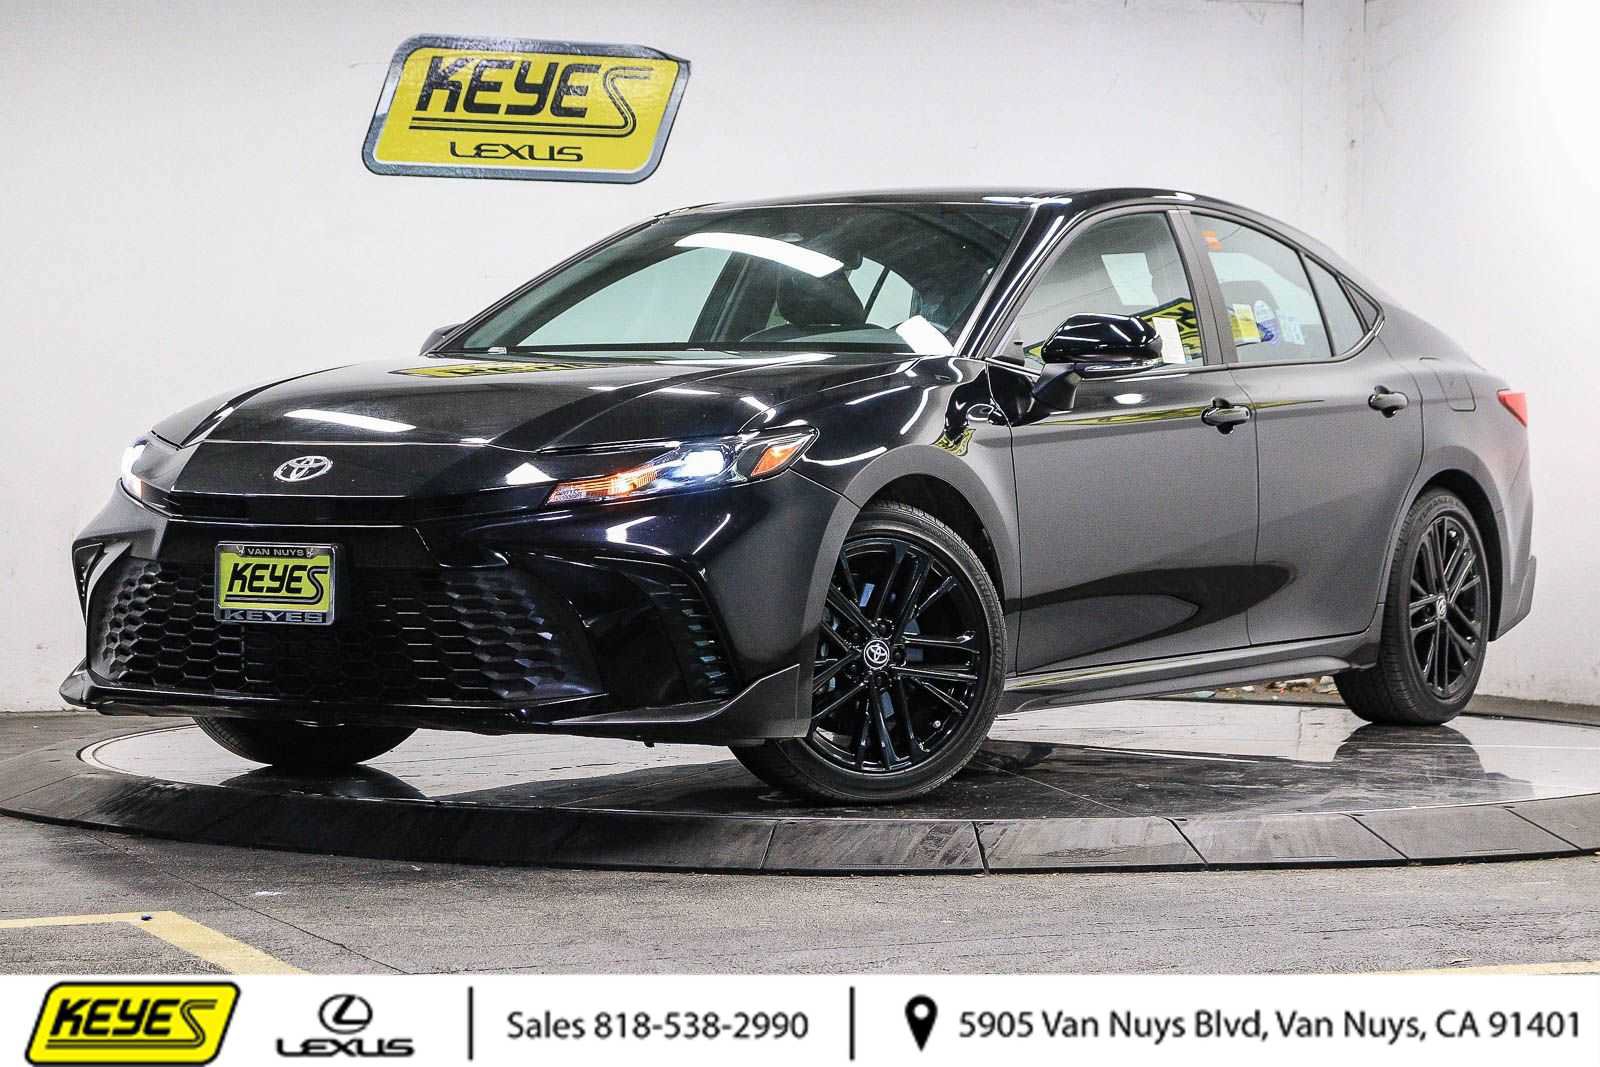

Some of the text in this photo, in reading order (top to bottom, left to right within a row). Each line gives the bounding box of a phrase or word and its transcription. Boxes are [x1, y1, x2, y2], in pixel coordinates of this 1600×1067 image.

[409, 55, 654, 137] KEYES
[450, 141, 584, 162] LEXUS
[247, 548, 305, 557] VAN NUYS
[224, 562, 329, 605] KEYES
[224, 610, 323, 622] KEYES
